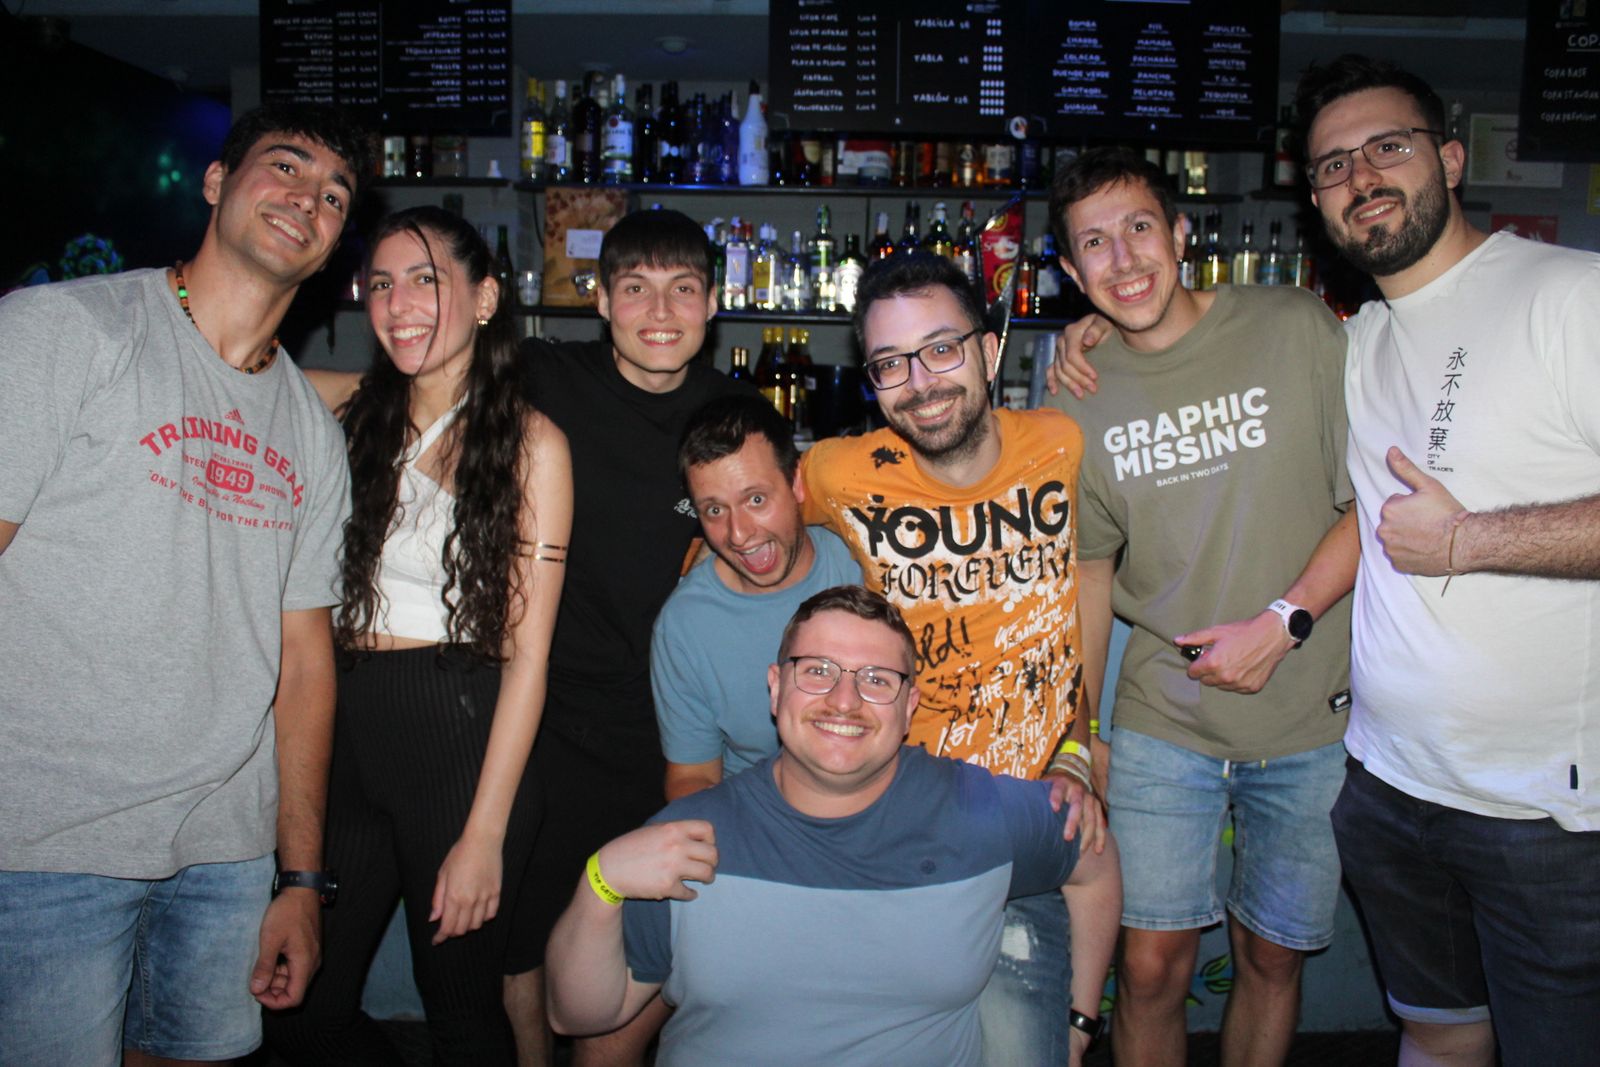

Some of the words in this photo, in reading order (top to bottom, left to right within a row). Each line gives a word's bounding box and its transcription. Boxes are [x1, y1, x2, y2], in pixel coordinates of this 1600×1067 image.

[1568, 33, 1600, 48] COP
[1103, 386, 1270, 454] GRAPHIC
[1427, 346, 1468, 451] 永不放棄
[1113, 418, 1267, 482] MISSING
[210, 463, 250, 489] 1949
[1156, 475, 1179, 487] BACK
[1180, 473, 1189, 481] IN
[1190, 469, 1210, 480] TWO
[1211, 462, 1229, 474] DAYS
[237, 516, 258, 528] THE
[849, 481, 1069, 558] YOUNG
